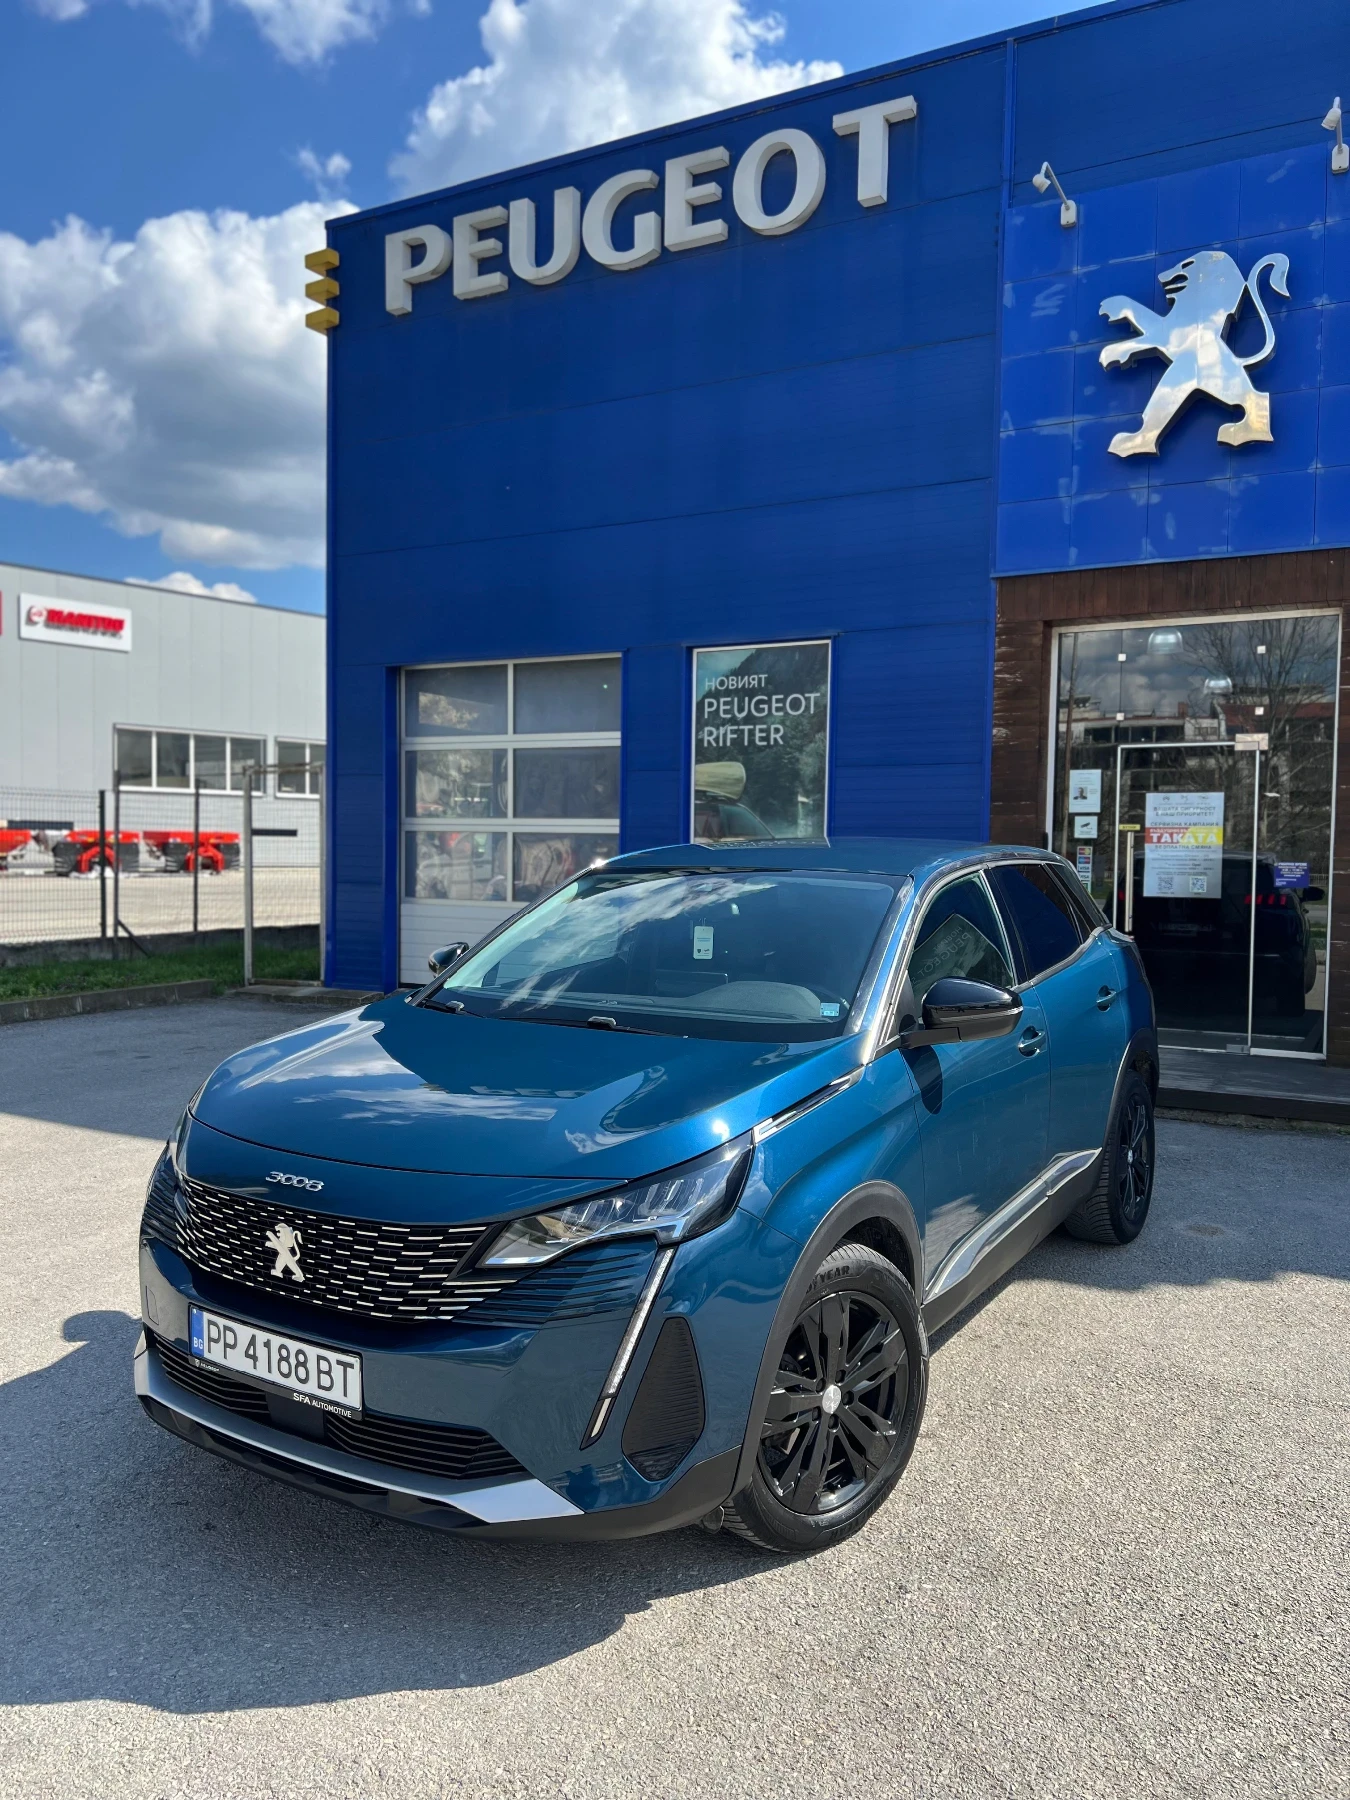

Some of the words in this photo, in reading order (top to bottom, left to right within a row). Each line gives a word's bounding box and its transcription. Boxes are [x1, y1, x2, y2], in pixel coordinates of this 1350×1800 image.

[384, 94, 917, 316] PEUGEOT
[705, 674, 768, 690] НОВИЯТ
[704, 693, 820, 719] PEUGEOT
[703, 724, 784, 748] RIFTER
[1149, 833, 1217, 843] ТАКАТА
[265, 1170, 325, 1192] 3008
[193, 1336, 204, 1351] BG
[207, 1319, 238, 1360] PP
[244, 1333, 311, 1385] 4188
[316, 1354, 355, 1398] BT
[293, 1392, 311, 1406] SFA
[311, 1398, 353, 1419] AUTOMOTIVE
